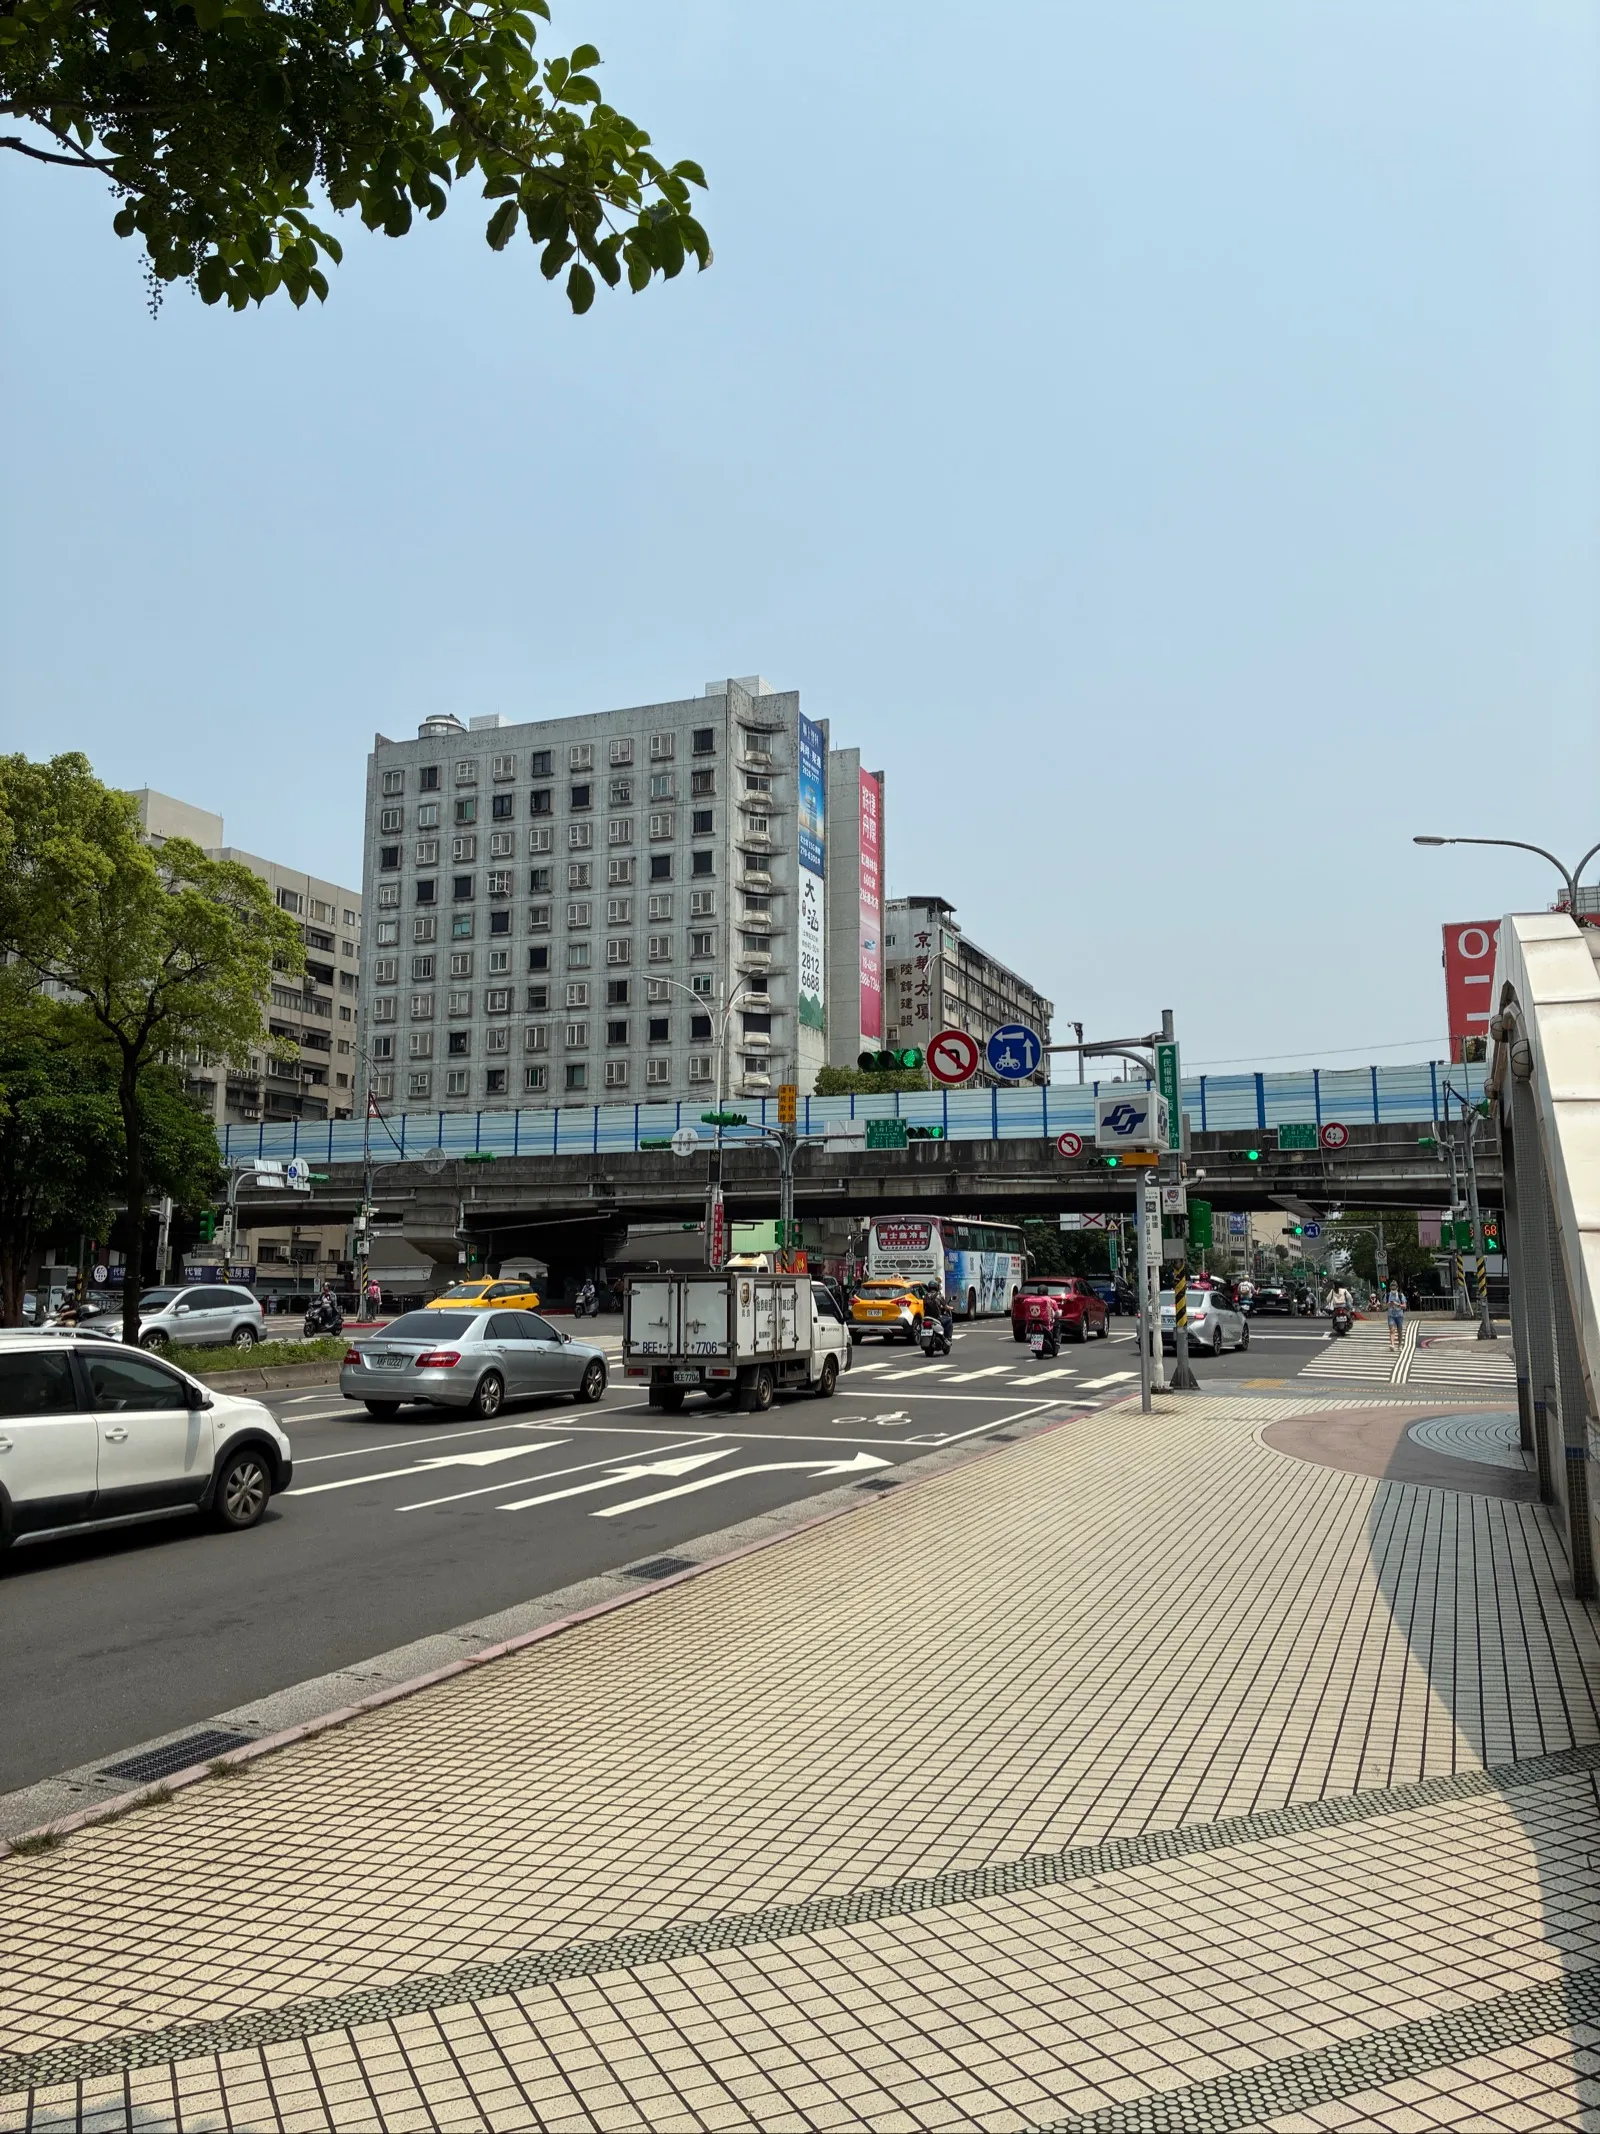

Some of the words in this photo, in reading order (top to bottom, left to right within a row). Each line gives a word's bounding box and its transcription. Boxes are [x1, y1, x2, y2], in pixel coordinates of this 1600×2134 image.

[802, 952, 820, 974] 2812
[802, 971, 820, 992] 6688
[1484, 1225, 1497, 1236] 68
[184, 1267, 203, 1276] 代管
[695, 1341, 718, 1354] 7706
